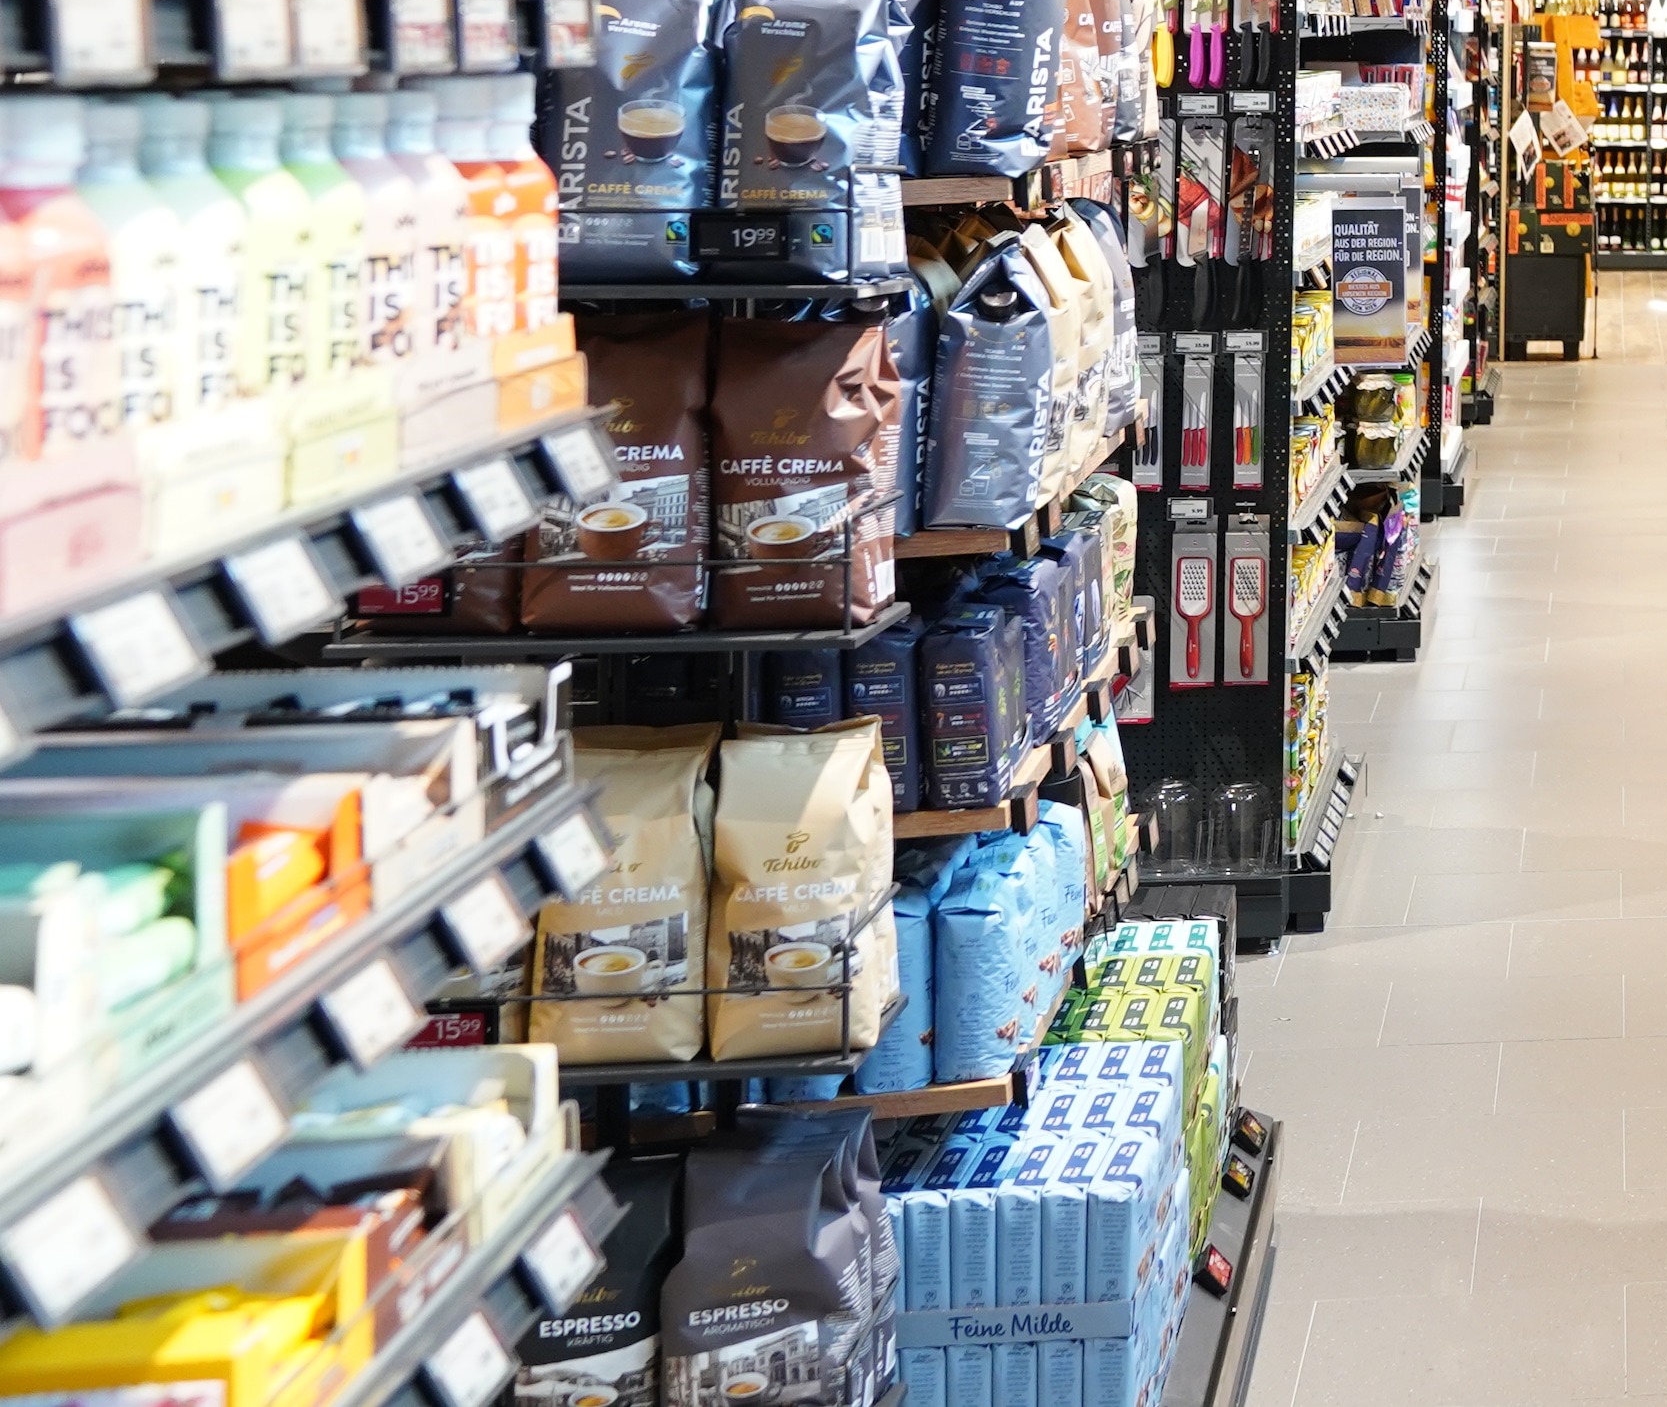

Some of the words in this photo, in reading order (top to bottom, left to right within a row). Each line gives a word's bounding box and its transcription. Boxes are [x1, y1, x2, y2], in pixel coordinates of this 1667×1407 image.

[587, 182, 631, 195] CAFFÈ
[741, 189, 777, 199] CAFFÈ
[780, 189, 828, 199] CREMA
[1334, 221, 1379, 236] QUALITÄT
[1334, 238, 1350, 248] AUS
[1351, 238, 1366, 248] DER
[1368, 238, 1397, 247] REGION
[1334, 250, 1349, 262] FÜR
[1351, 252, 1364, 261] DIE
[1366, 250, 1403, 261] REGION.
[1025, 368, 1051, 502] BARISTA
[614, 445, 684, 461] CREMA
[720, 455, 772, 475] CAFFÈ
[777, 459, 844, 474] CREMA
[745, 476, 811, 487] VOLLMUNDIG
[763, 856, 826, 873] Tchibo
[608, 885, 681, 904] CREMA
[689, 1298, 789, 1326] ESPRESSO
[539, 1311, 641, 1338] ESPRESSO
[703, 1316, 775, 1336] AROMATISCH
[948, 1315, 1005, 1340] Feine
[1011, 1312, 1074, 1337] Milde
[567, 1334, 614, 1347] KRÄFTIG
